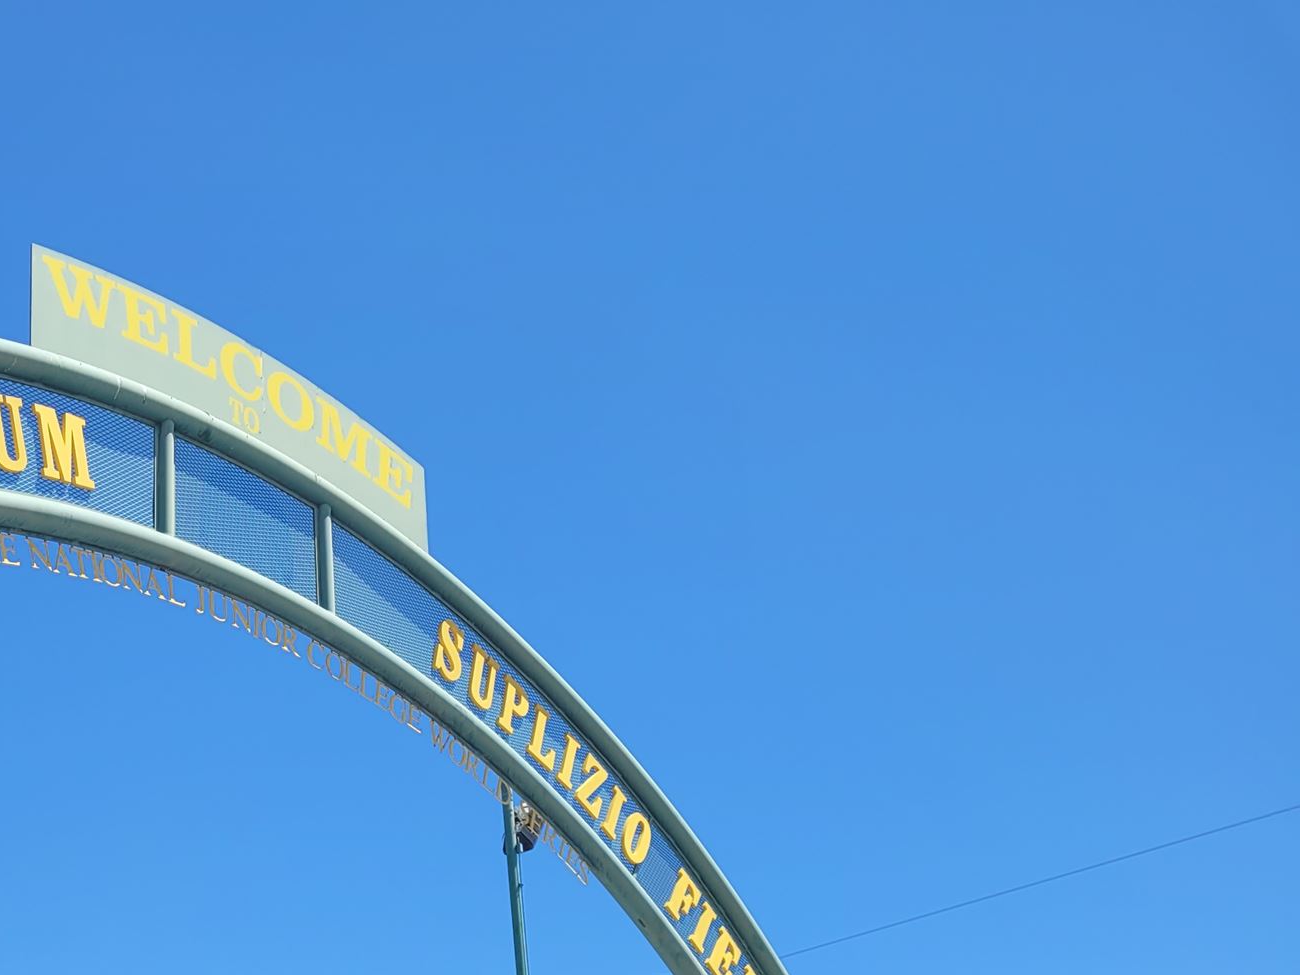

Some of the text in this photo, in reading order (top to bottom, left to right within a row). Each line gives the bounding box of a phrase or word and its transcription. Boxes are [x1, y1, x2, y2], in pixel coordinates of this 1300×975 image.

[42, 254, 413, 510] WELCOME
[229, 397, 261, 435] TO
[27, 537, 186, 607] NATIONAL
[195, 586, 301, 658] JUNIOR
[307, 640, 422, 733] COLLEGE
[430, 721, 514, 804] WORLD
[433, 619, 652, 865] SUPLIZIO
